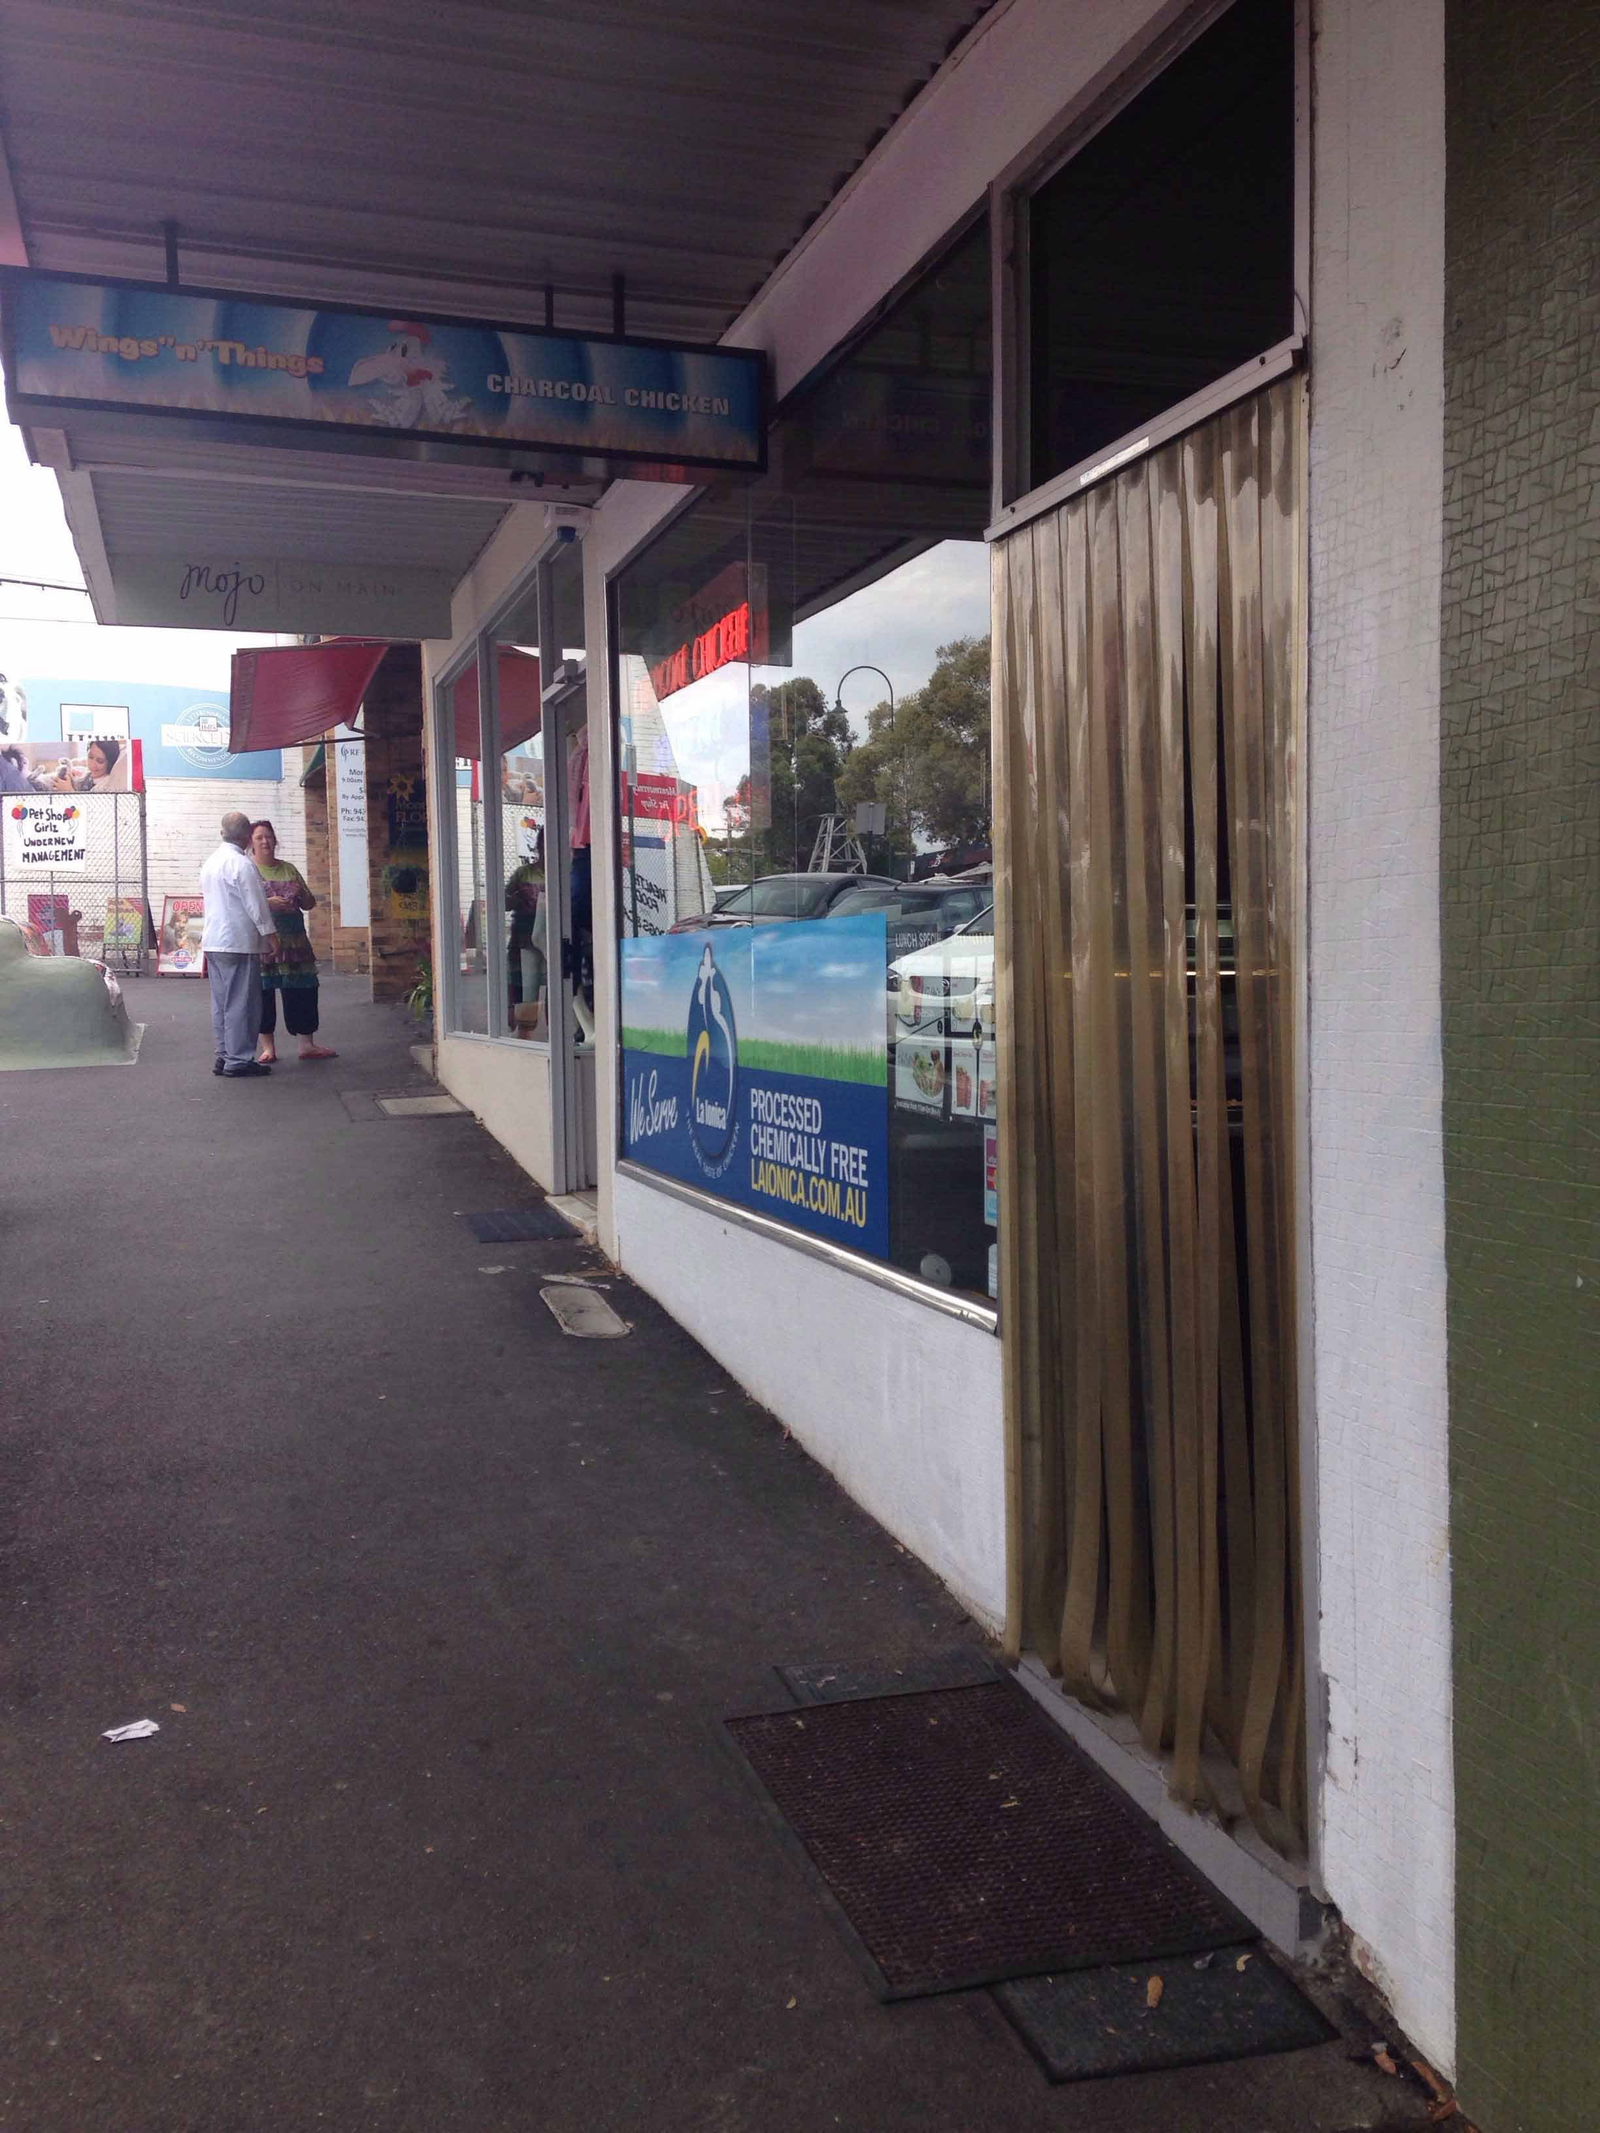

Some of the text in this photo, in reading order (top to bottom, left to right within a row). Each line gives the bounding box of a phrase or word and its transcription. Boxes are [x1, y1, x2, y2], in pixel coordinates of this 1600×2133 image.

[486, 373, 731, 416] CHARCOAL CHICKEN
[29, 808, 71, 823] Pet Shop
[34, 822, 59, 833] Girlz
[22, 848, 86, 863] MANAGEMENT
[172, 899, 204, 913] OPEN
[895, 932, 918, 948] LUNCH
[630, 1072, 645, 1144] We
[645, 1069, 678, 1137] Serve
[750, 1087, 822, 1134] PROCESSED
[750, 1123, 827, 1175] CHEMICALLY
[830, 1141, 869, 1188] FREE
[751, 1157, 867, 1228] LAIONICA.COM.AU
